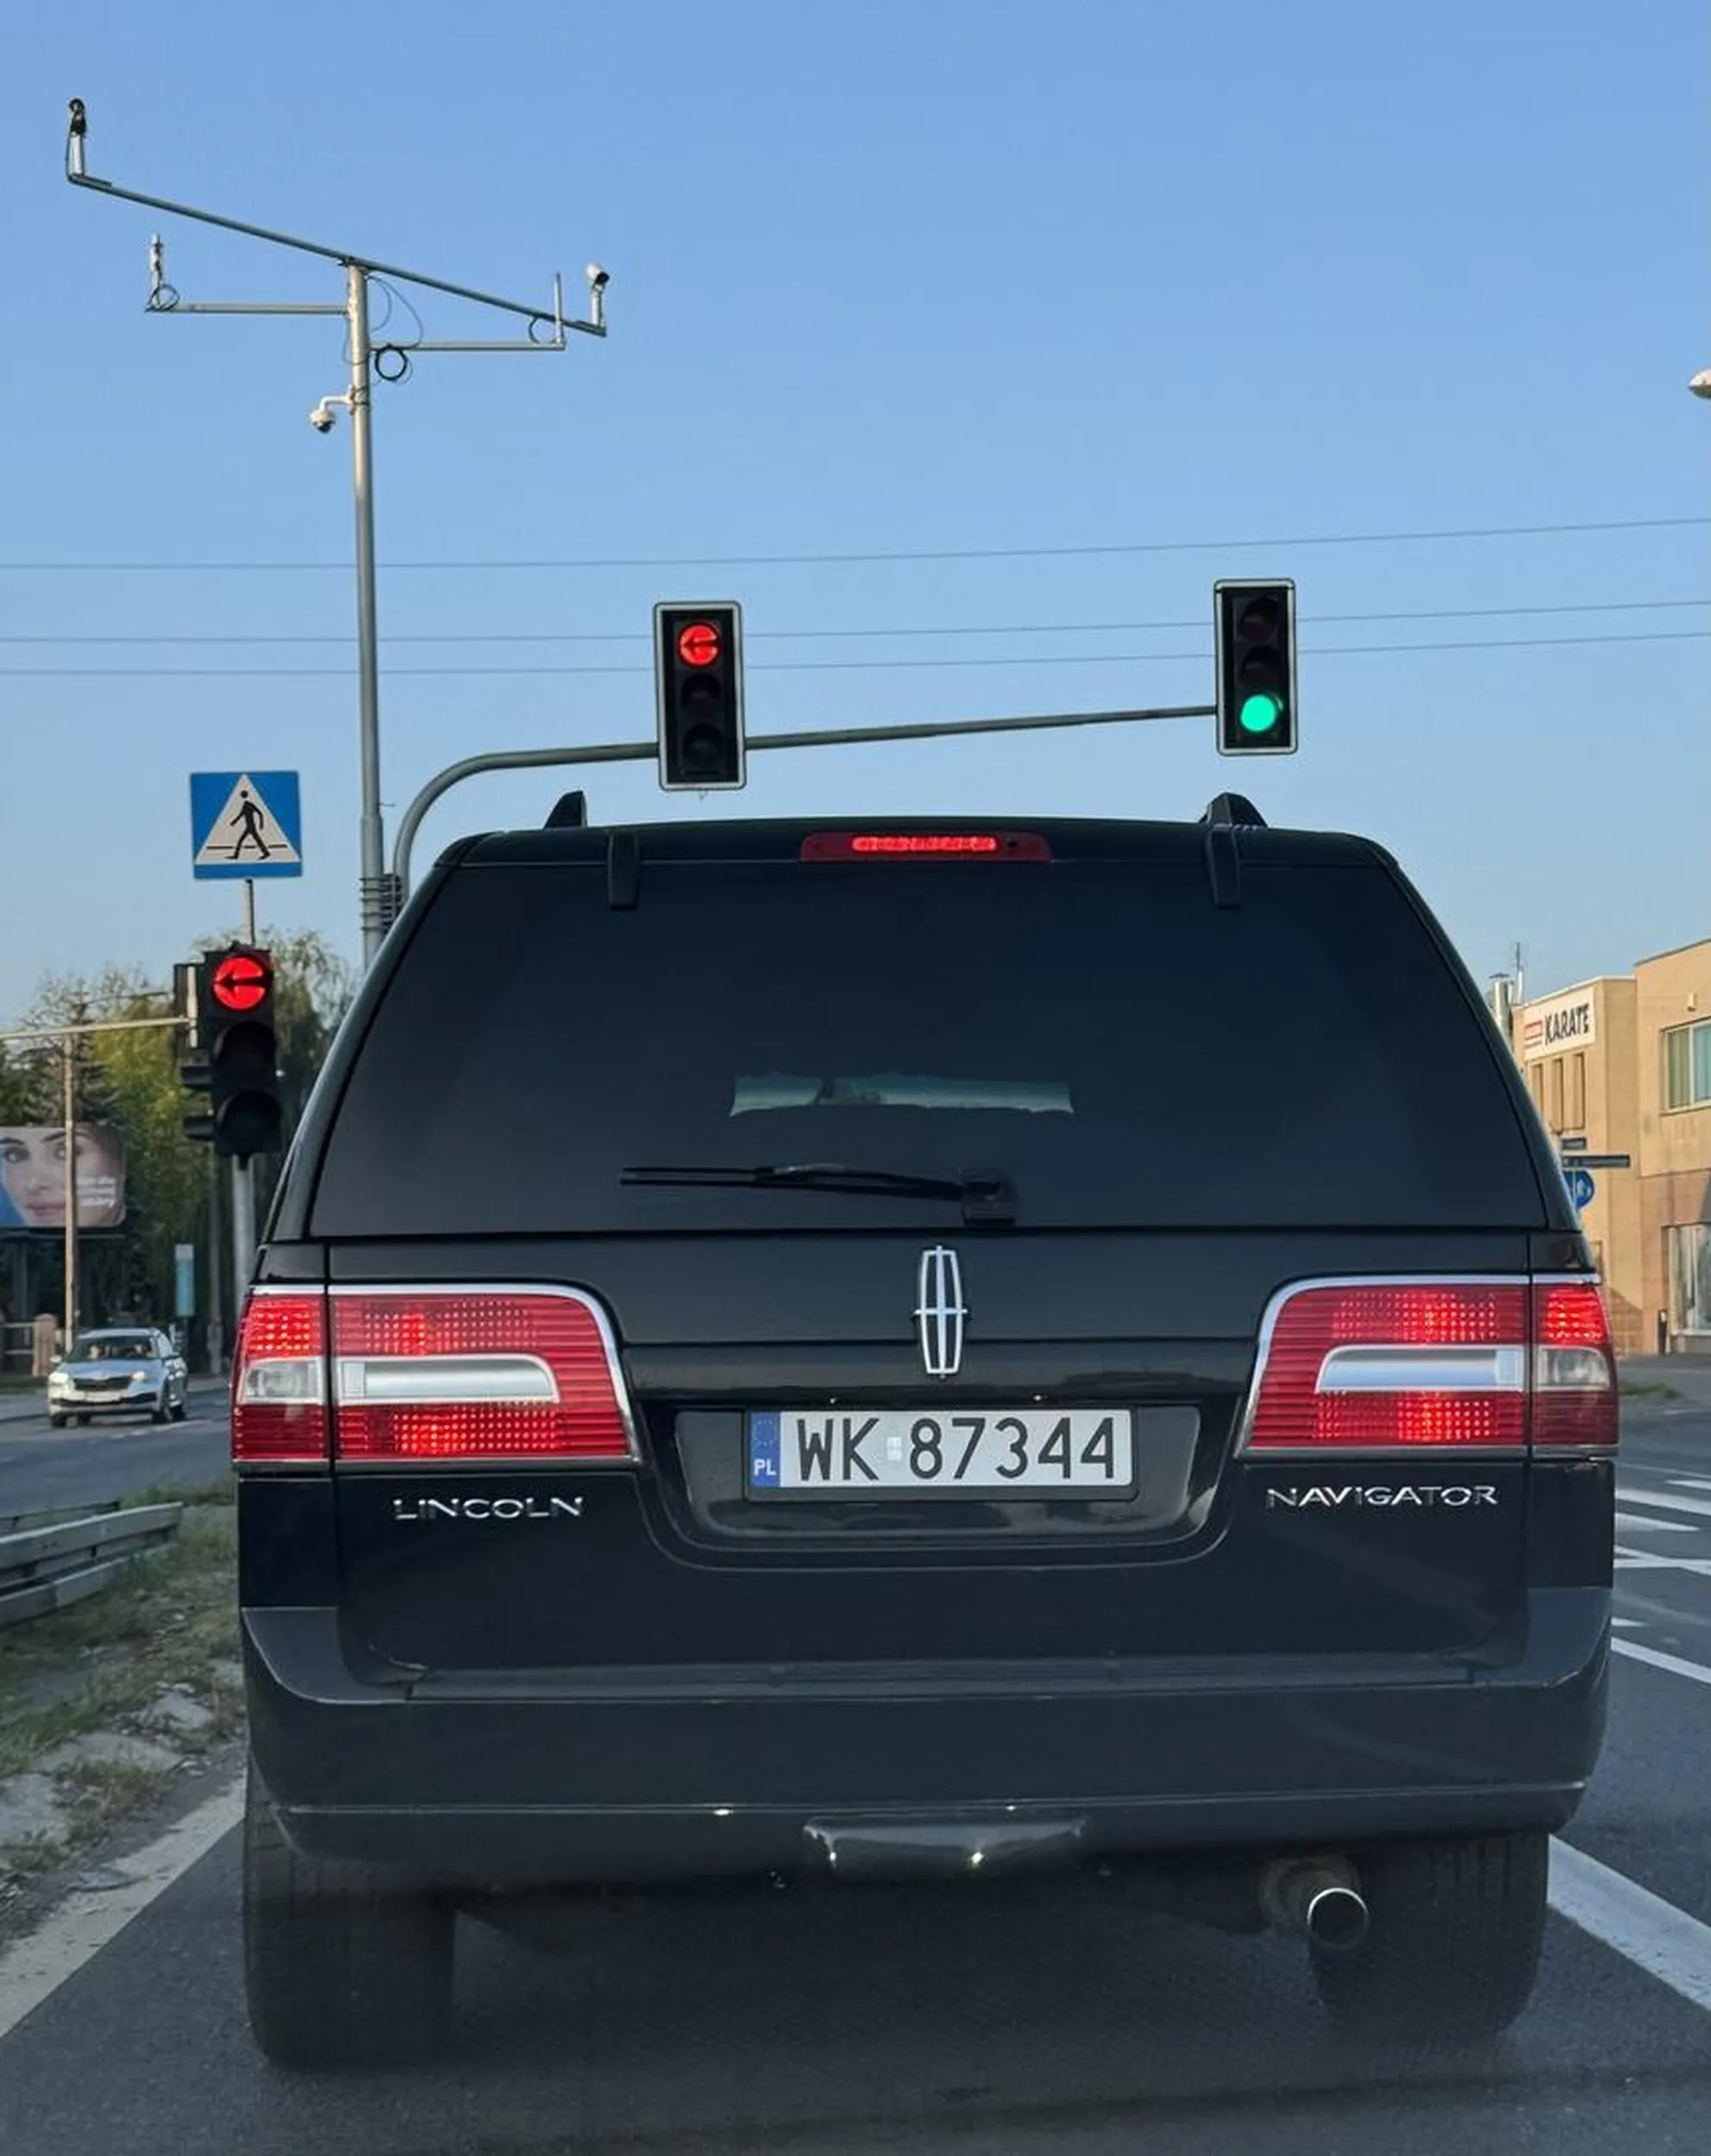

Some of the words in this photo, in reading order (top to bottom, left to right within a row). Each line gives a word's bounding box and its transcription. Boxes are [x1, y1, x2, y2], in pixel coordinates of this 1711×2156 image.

[1545, 1003, 1589, 1045] KARATE
[796, 1417, 879, 1481] WK
[910, 1417, 1114, 1481] 87344
[754, 1459, 777, 1476] PL
[392, 1496, 584, 1520] LINCOLN
[1265, 1485, 1498, 1508] NAVIGATOR
